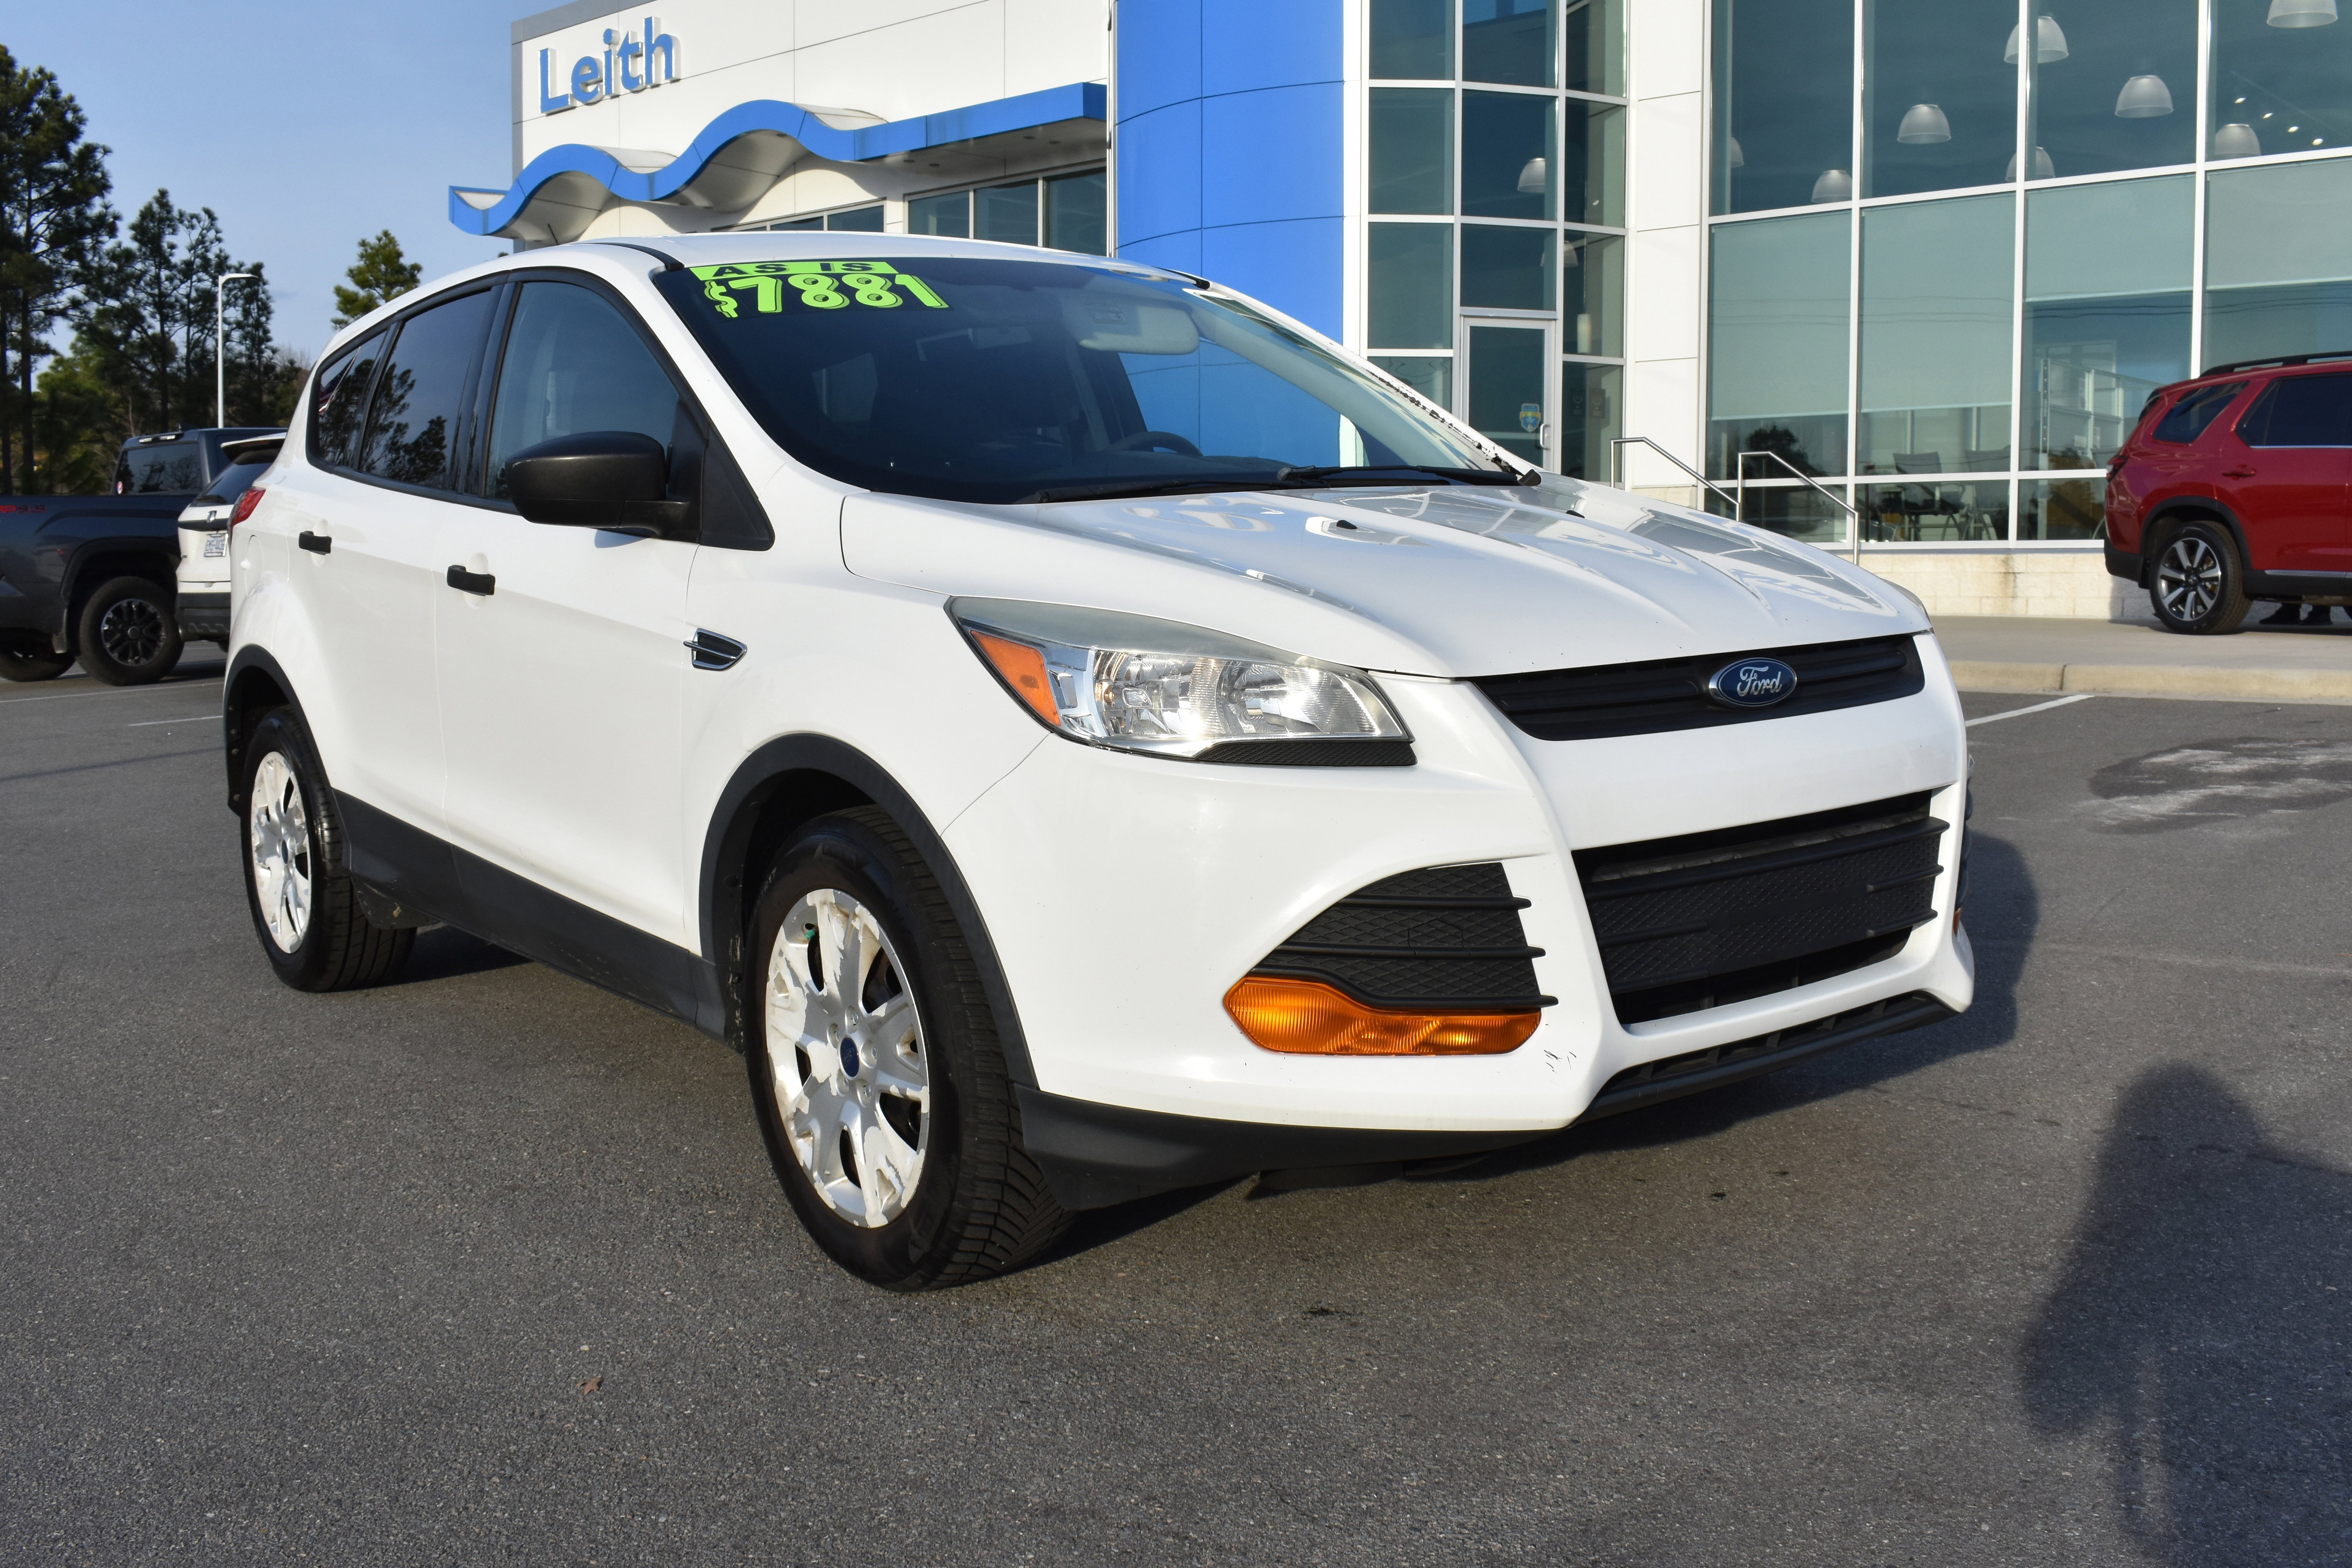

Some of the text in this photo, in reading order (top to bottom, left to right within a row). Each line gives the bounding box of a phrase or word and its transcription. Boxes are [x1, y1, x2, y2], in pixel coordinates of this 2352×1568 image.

[539, 16, 679, 114] Leith
[712, 263, 877, 277] AS IS
[704, 274, 949, 318] $7881
[1737, 666, 1782, 697] Ford
